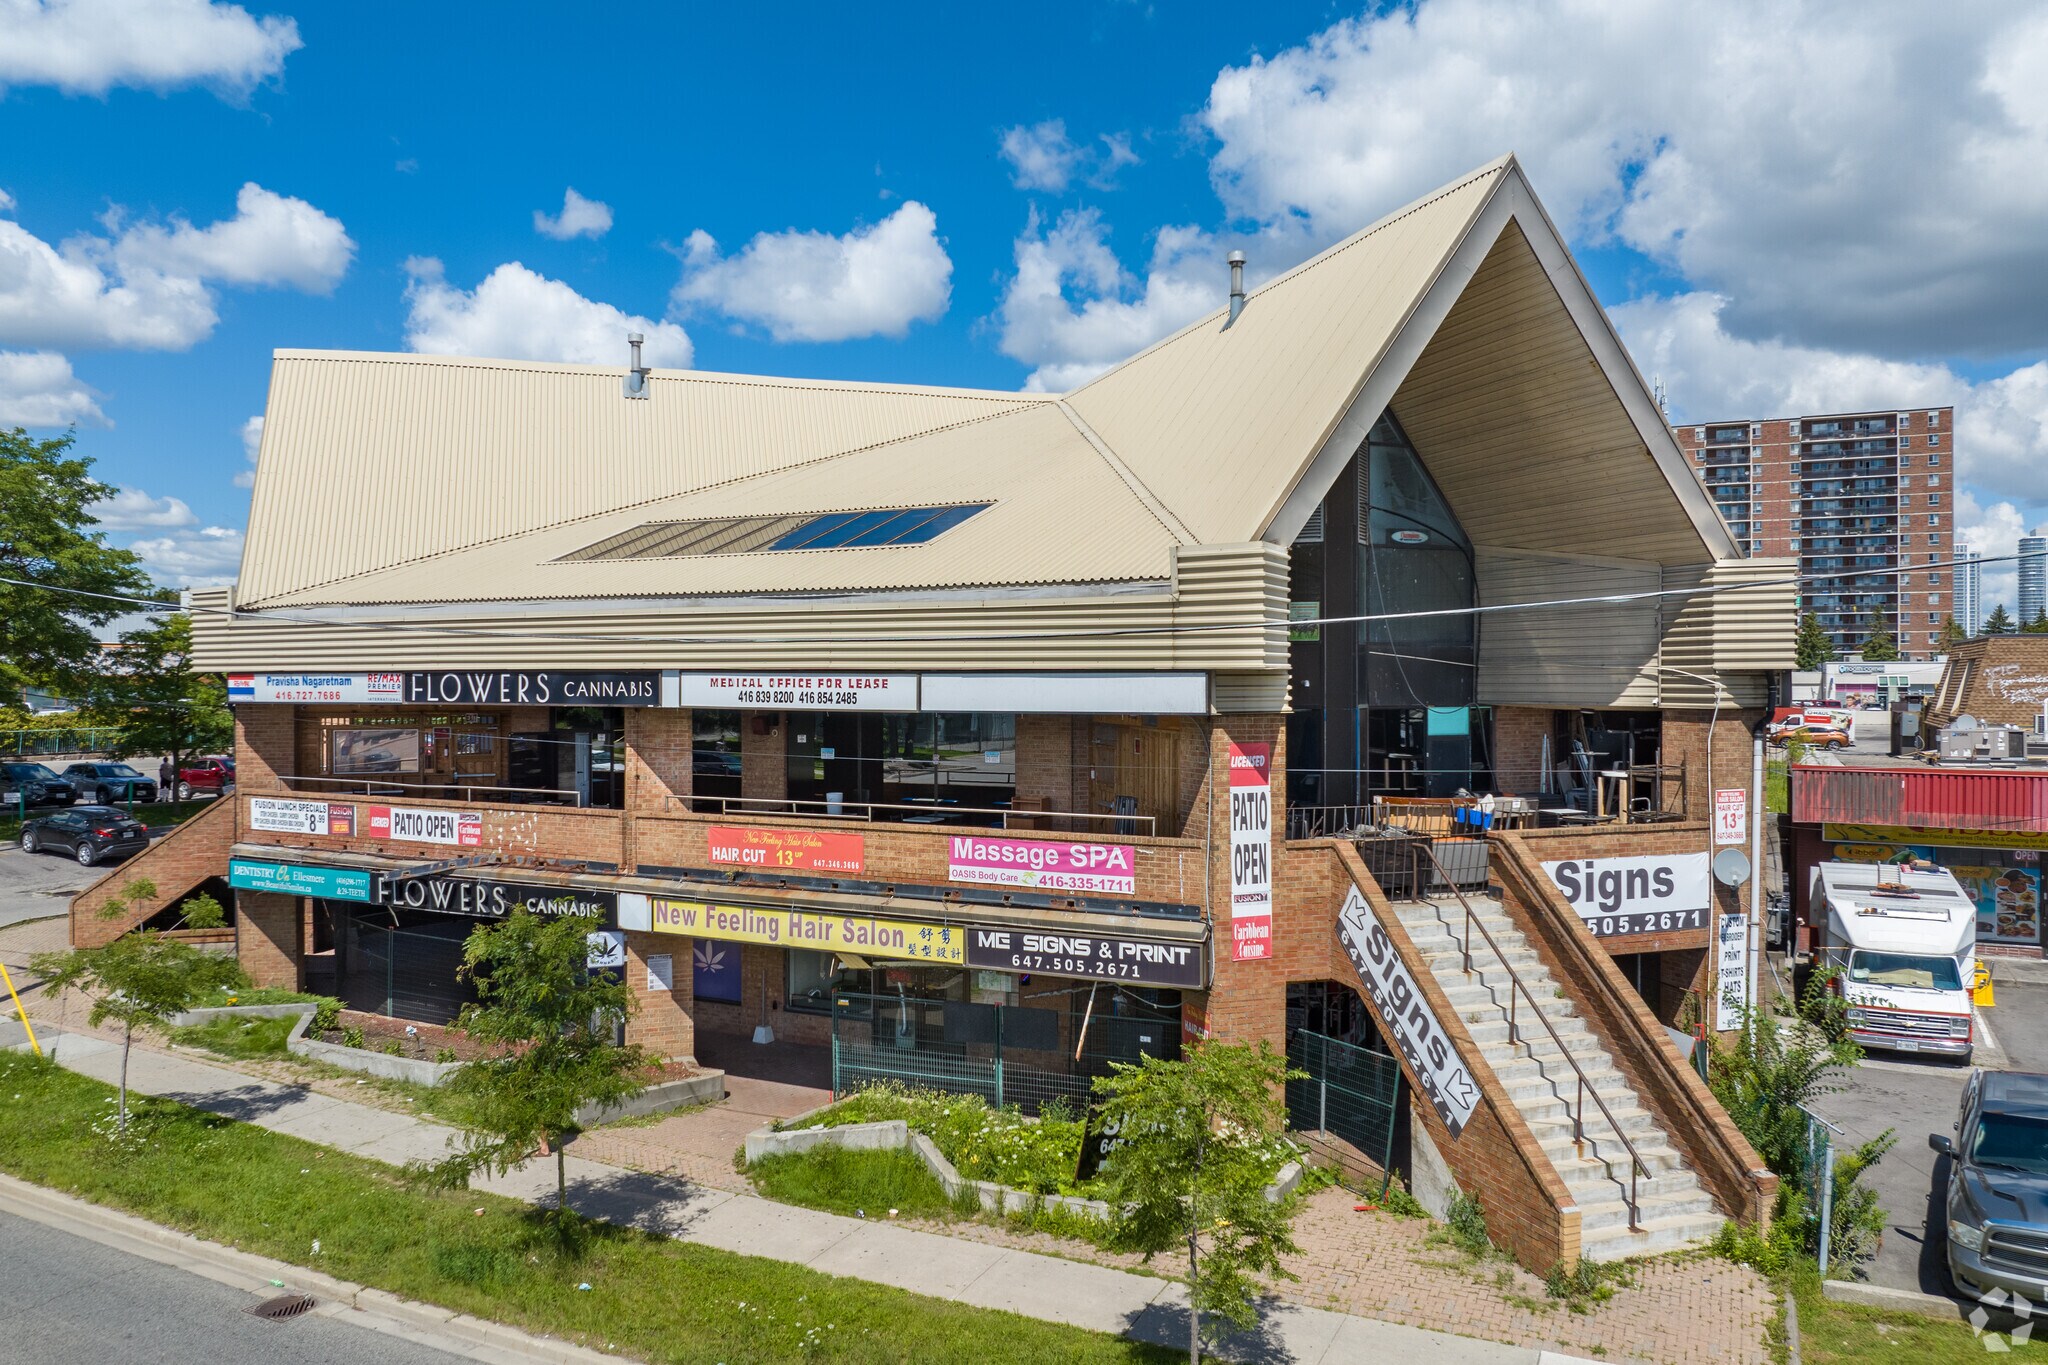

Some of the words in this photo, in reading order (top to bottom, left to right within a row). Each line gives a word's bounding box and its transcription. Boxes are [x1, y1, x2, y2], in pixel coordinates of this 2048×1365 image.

[266, 676, 300, 686] Pravisha
[302, 676, 352, 688] Nagaretnam
[368, 673, 401, 683] RE/MAX
[710, 678, 763, 688] MEDICAL
[768, 678, 812, 689] OFFICE
[818, 678, 843, 690] FOR
[848, 678, 889, 690] LEASE
[275, 691, 341, 700] 416.727.7686
[411, 673, 550, 704] FLOWERS
[563, 680, 653, 698] CANNABIS
[738, 690, 754, 704] 416
[756, 690, 772, 704] 839
[773, 690, 795, 704] 8200
[798, 690, 816, 704] 416
[817, 691, 834, 705] 854
[835, 691, 858, 706] 2485
[1230, 755, 1265, 768] LICENSED
[255, 800, 276, 810] FUSION
[278, 802, 297, 812] LUNCH
[298, 803, 326, 814] SPECIALS
[330, 806, 352, 816] FUSION
[1233, 791, 1268, 832] PATIO
[1718, 804, 1731, 812] HAIR
[394, 812, 422, 836] PATIO
[426, 815, 454, 838] OPEN
[1722, 812, 1736, 829] 13
[743, 830, 758, 844] New
[759, 832, 783, 850] Feeling
[784, 832, 801, 847] Hair
[802, 834, 822, 849] Salon
[712, 846, 740, 862] HAIR
[742, 848, 766, 864] CUT
[776, 850, 794, 866] 13
[954, 837, 1059, 870] Massage
[1070, 845, 1128, 870] SPA
[2014, 850, 2038, 861] OPEN
[1234, 842, 1268, 886] OPEN
[234, 865, 275, 879] DENTISTRY
[276, 864, 290, 881] On
[293, 871, 325, 884] Ellesmere
[952, 869, 977, 879] OASIS
[978, 870, 999, 882] Body
[1000, 872, 1018, 882] Care
[1038, 874, 1132, 892] 416-335-1711
[1555, 861, 1675, 913] Signs
[378, 877, 506, 916] FLOWERS
[526, 896, 600, 918] CANNABIS
[656, 900, 698, 927] New
[706, 904, 780, 942] Feeling
[789, 912, 834, 940] Hair
[842, 916, 904, 948] Salon
[1234, 922, 1269, 940] Caribbean
[1023, 934, 1092, 956] SIGNS
[1098, 942, 1112, 959] &
[1118, 942, 1192, 966] PRINT
[1239, 941, 1264, 958] Cuisine
[1724, 950, 1741, 962] PRINT
[1012, 954, 1140, 978] 647.505.2671
[1721, 966, 1744, 978] T-SHIRTS
[1724, 980, 1742, 993] HATS
[1366, 923, 1448, 1072] Signs
[1340, 928, 1454, 1126] 647.505.2671
